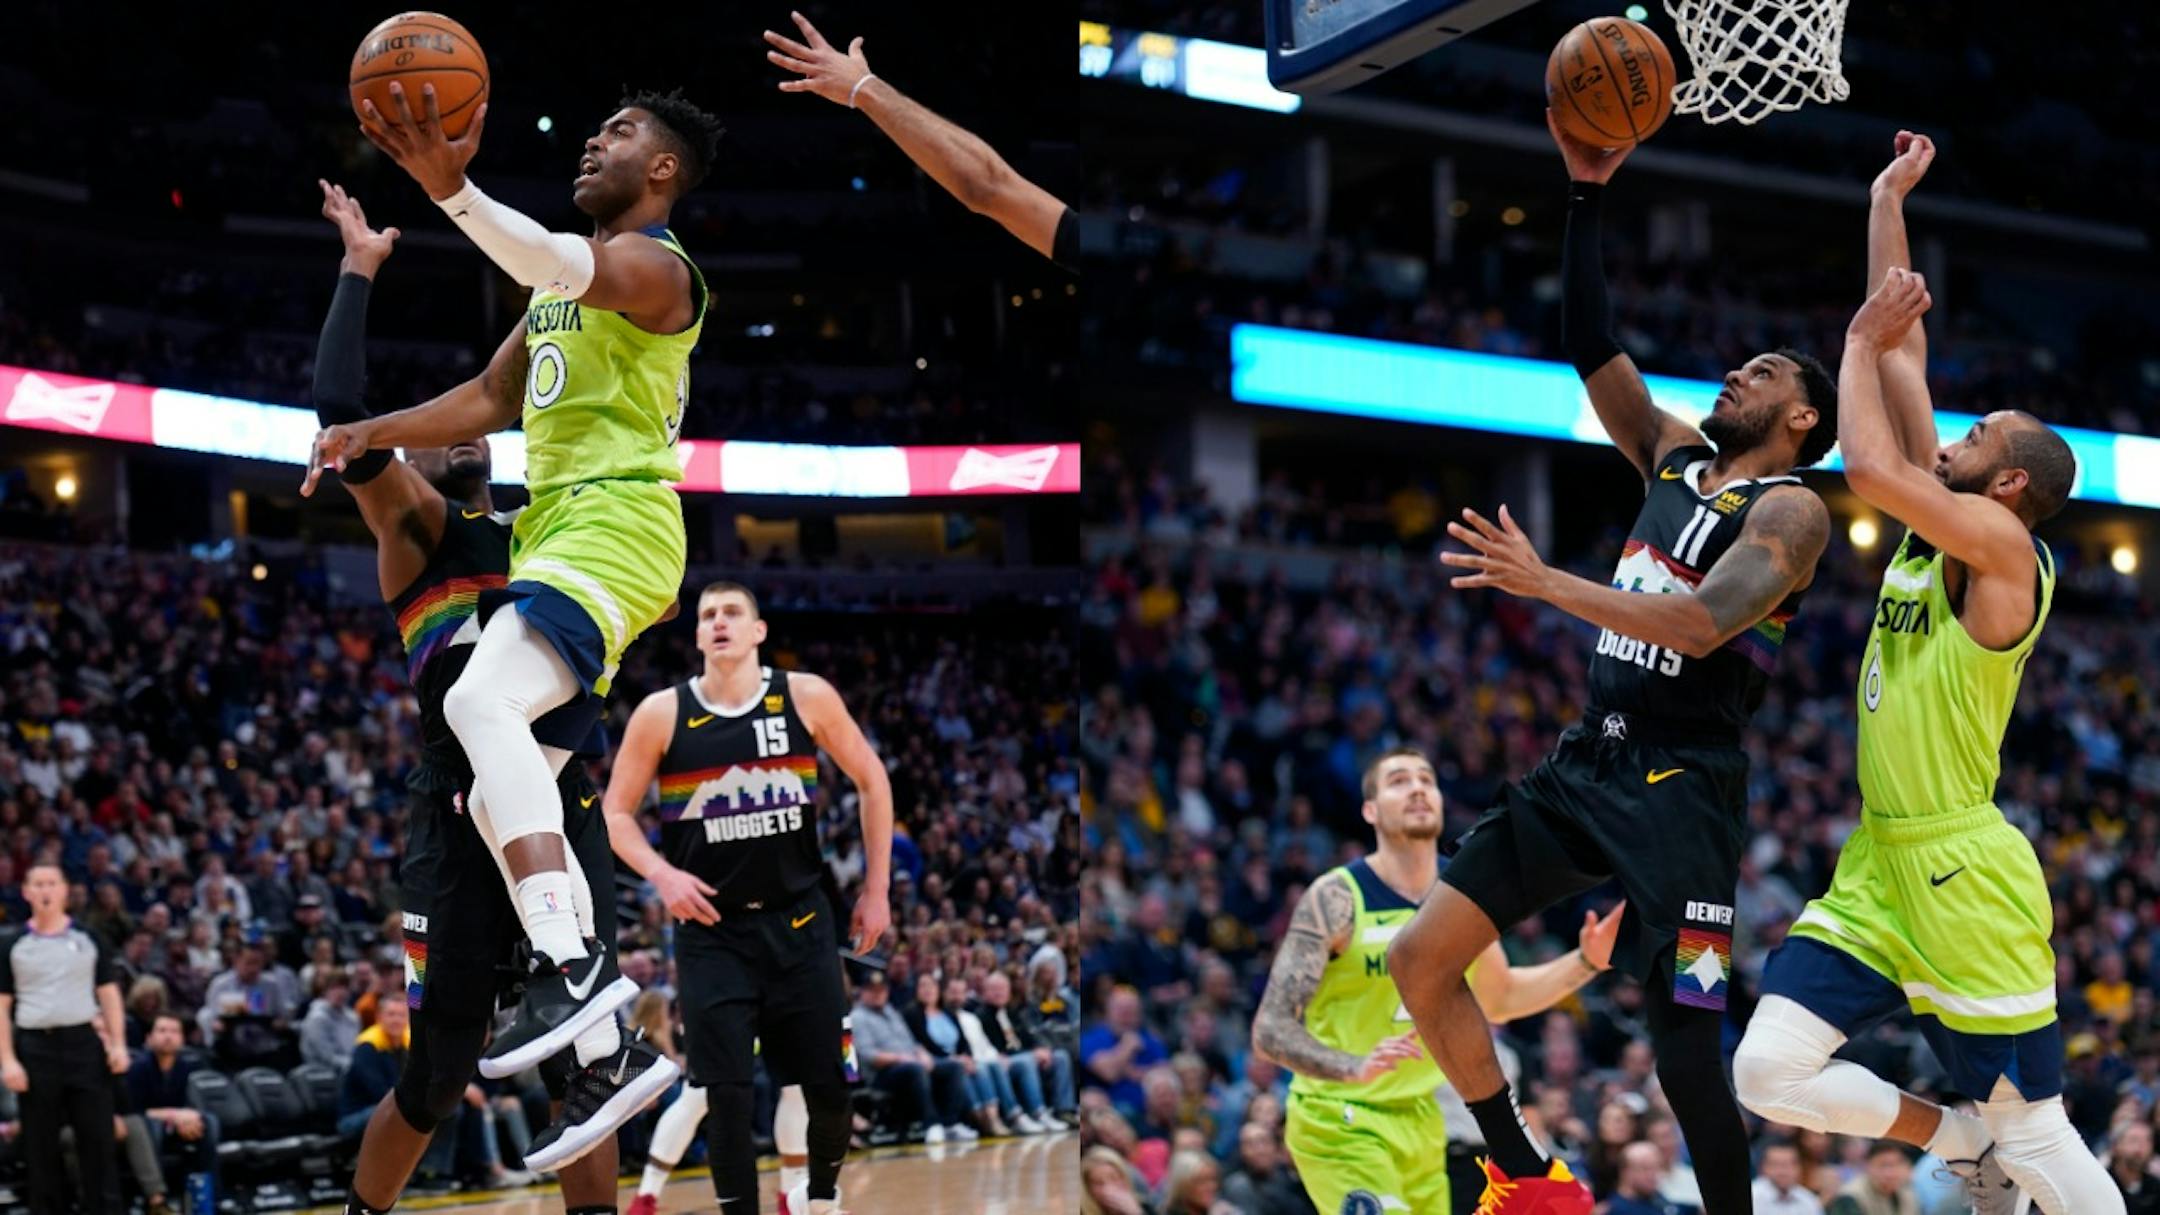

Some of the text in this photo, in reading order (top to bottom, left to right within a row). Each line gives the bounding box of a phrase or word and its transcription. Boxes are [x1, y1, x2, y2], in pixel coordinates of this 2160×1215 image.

[1597, 23, 1652, 107] SPALDING
[527, 300, 582, 334] NESOTA
[529, 341, 568, 409] 0
[1671, 503, 1721, 568] 11
[1877, 597, 1929, 636] SOTA
[1596, 626, 1684, 677] UGGETS
[752, 715, 790, 758] 15
[703, 805, 804, 844] NUGGETS
[1684, 900, 1735, 926] DENVER
